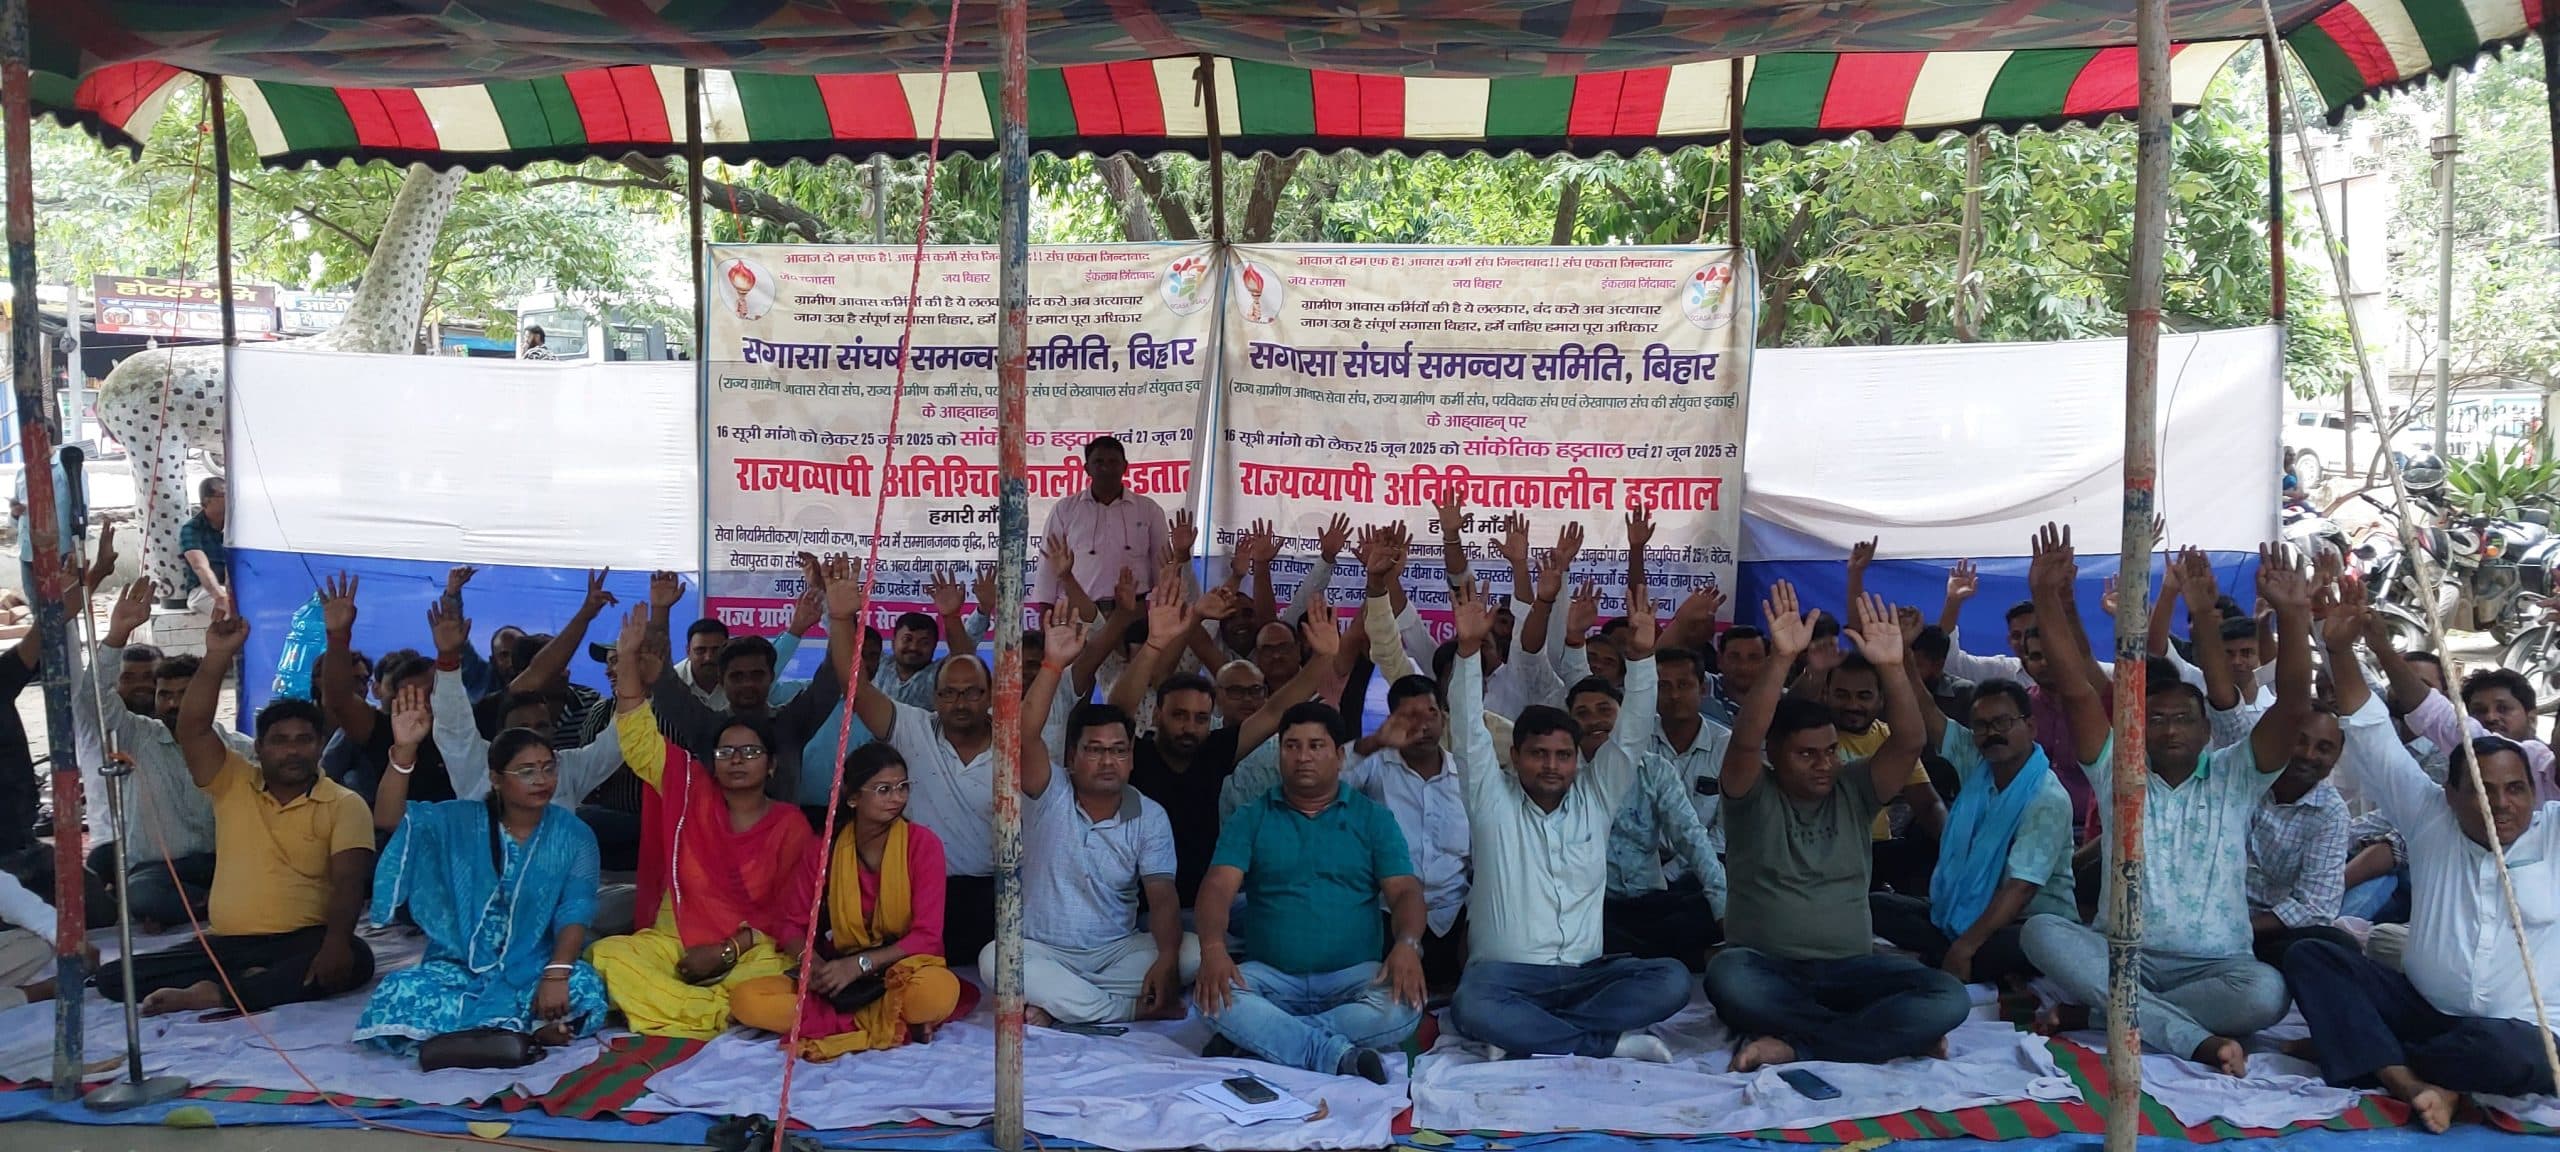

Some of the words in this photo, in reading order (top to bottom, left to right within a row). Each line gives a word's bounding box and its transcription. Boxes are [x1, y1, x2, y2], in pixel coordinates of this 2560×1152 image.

[785, 254, 820, 263] आवाज
[824, 252, 834, 262] दो
[838, 254, 853, 263] हम
[857, 255, 876, 263] एक
[961, 250, 978, 261] संघ
[1046, 250, 1063, 262] संघ
[1067, 253, 1097, 262] एकता
[1296, 256, 1333, 266] आवाज
[1335, 254, 1348, 265] दो
[1350, 257, 1367, 266] हम
[1370, 257, 1388, 266] एक
[1408, 258, 1444, 267] आवास
[1475, 256, 1493, 267] संघ
[1562, 255, 1581, 268] संघ
[942, 274, 960, 285] जय
[1288, 276, 1307, 286] जय
[1453, 279, 1471, 289] जय
[794, 294, 835, 306] ग्रामीण
[839, 297, 877, 307] आवास
[924, 296, 942, 307] की
[944, 296, 954, 307] है
[956, 296, 966, 307] ये
[1043, 296, 1067, 307] करो
[1094, 296, 1144, 306] अत्याचार
[1301, 299, 1342, 311] ग्रामीण
[1346, 301, 1384, 312] आवास
[1387, 300, 1429, 313] कर्मियों
[1432, 300, 1450, 313] की
[1452, 301, 1461, 313] है
[1464, 302, 1474, 313] ये
[1554, 302, 1579, 315] करो
[1608, 304, 1662, 315] अत्याचार
[794, 313, 820, 323] जाग
[825, 313, 844, 323] उठा
[848, 311, 857, 323] है
[859, 311, 890, 327] संपूर्ण
[977, 313, 996, 325] हमें
[1036, 315, 1068, 324] हमारा
[1071, 314, 1090, 327] पूरा
[1094, 313, 1142, 323] अधिकार
[1301, 318, 1326, 328] जाग
[1330, 318, 1350, 329] उठा
[1354, 317, 1363, 329] है
[1365, 316, 1396, 333] संपूर्ण
[1400, 321, 1441, 331] सगासा
[1485, 319, 1505, 332] हमें
[1507, 320, 1542, 333] चाहिए
[1545, 322, 1580, 332] हमारा
[1583, 322, 1603, 336] पूरा
[1607, 320, 1658, 332] अधिकार
[742, 337, 831, 369] सगासा
[836, 336, 908, 370] संघर्ष
[1027, 334, 1119, 373] समिति,
[1128, 332, 1197, 370] बिहार
[1250, 342, 1338, 377] सगासा
[1343, 341, 1414, 378] संघर्ष
[1418, 352, 1527, 380] समन्वय
[1532, 343, 1633, 384] समिति,
[1643, 343, 1720, 384] बिहार
[818, 381, 839, 396] सेवा
[866, 385, 892, 397] राज्य
[933, 383, 959, 397] कर्मी
[1032, 383, 1050, 397] संघ
[1052, 383, 1068, 397] एवं
[1069, 382, 1117, 397] लेखापाल
[1119, 381, 1136, 396] संघ
[1149, 378, 1183, 397] संयुक्त
[1256, 382, 1291, 398] ग्रामीण
[1294, 386, 1324, 400] आवास
[1326, 388, 1345, 404] सेवा
[1373, 393, 1397, 405] राज्य
[1400, 391, 1435, 407] ग्रामीण
[1439, 391, 1464, 406] कर्मी
[1540, 392, 1558, 408] संघ
[1561, 392, 1577, 408] एवं
[1579, 393, 1627, 409] लेखापाल
[1630, 393, 1648, 409] संघ
[1651, 393, 1666, 408] की
[1669, 393, 1700, 412] संयुक्त
[922, 402, 936, 418] के
[1427, 411, 1441, 427] के
[1510, 416, 1527, 429] पर
[717, 425, 728, 438] 16
[732, 425, 760, 443] सूत्री
[800, 429, 818, 443] को
[820, 431, 859, 446] लेकर
[861, 432, 874, 446] 25
[907, 432, 933, 446] 2025
[937, 431, 956, 446] को
[1136, 430, 1148, 443] 27
[1151, 430, 1177, 446] जून
[1224, 429, 1235, 441] 16
[1239, 430, 1264, 448] सूत्री
[1305, 434, 1324, 449] को
[1328, 436, 1363, 453] लेकर
[1364, 440, 1378, 454] 25
[1380, 444, 1406, 458] जून
[1409, 441, 1436, 455] 2025
[1439, 441, 1460, 456] को
[1463, 436, 1552, 457] सांकेतिक
[1556, 442, 1626, 462] हड़ताल
[1627, 443, 1649, 460] एवं
[1650, 445, 1663, 459] 27
[1666, 445, 1691, 462] जून
[1695, 445, 1721, 458] 2025
[1725, 443, 1738, 458] से
[733, 454, 874, 498] राज्यव्यापी
[1239, 462, 1377, 503] राज्यव्यापी
[1384, 463, 1617, 511] अनिश्चितकालीन
[928, 504, 975, 525] हमारी
[714, 524, 734, 542] सेवा
[891, 530, 901, 548] में
[903, 535, 961, 549] सम्मानजनक
[1217, 528, 1235, 544] सेवा
[770, 554, 783, 568] का
[1644, 545, 1681, 567] नियुक्ति
[1682, 545, 1692, 563] में
[1270, 560, 1284, 572] का
[1434, 568, 1447, 580] का
[775, 579, 793, 598] आयु
[1671, 574, 1692, 592] लागू
[716, 606, 756, 627] राज्य
